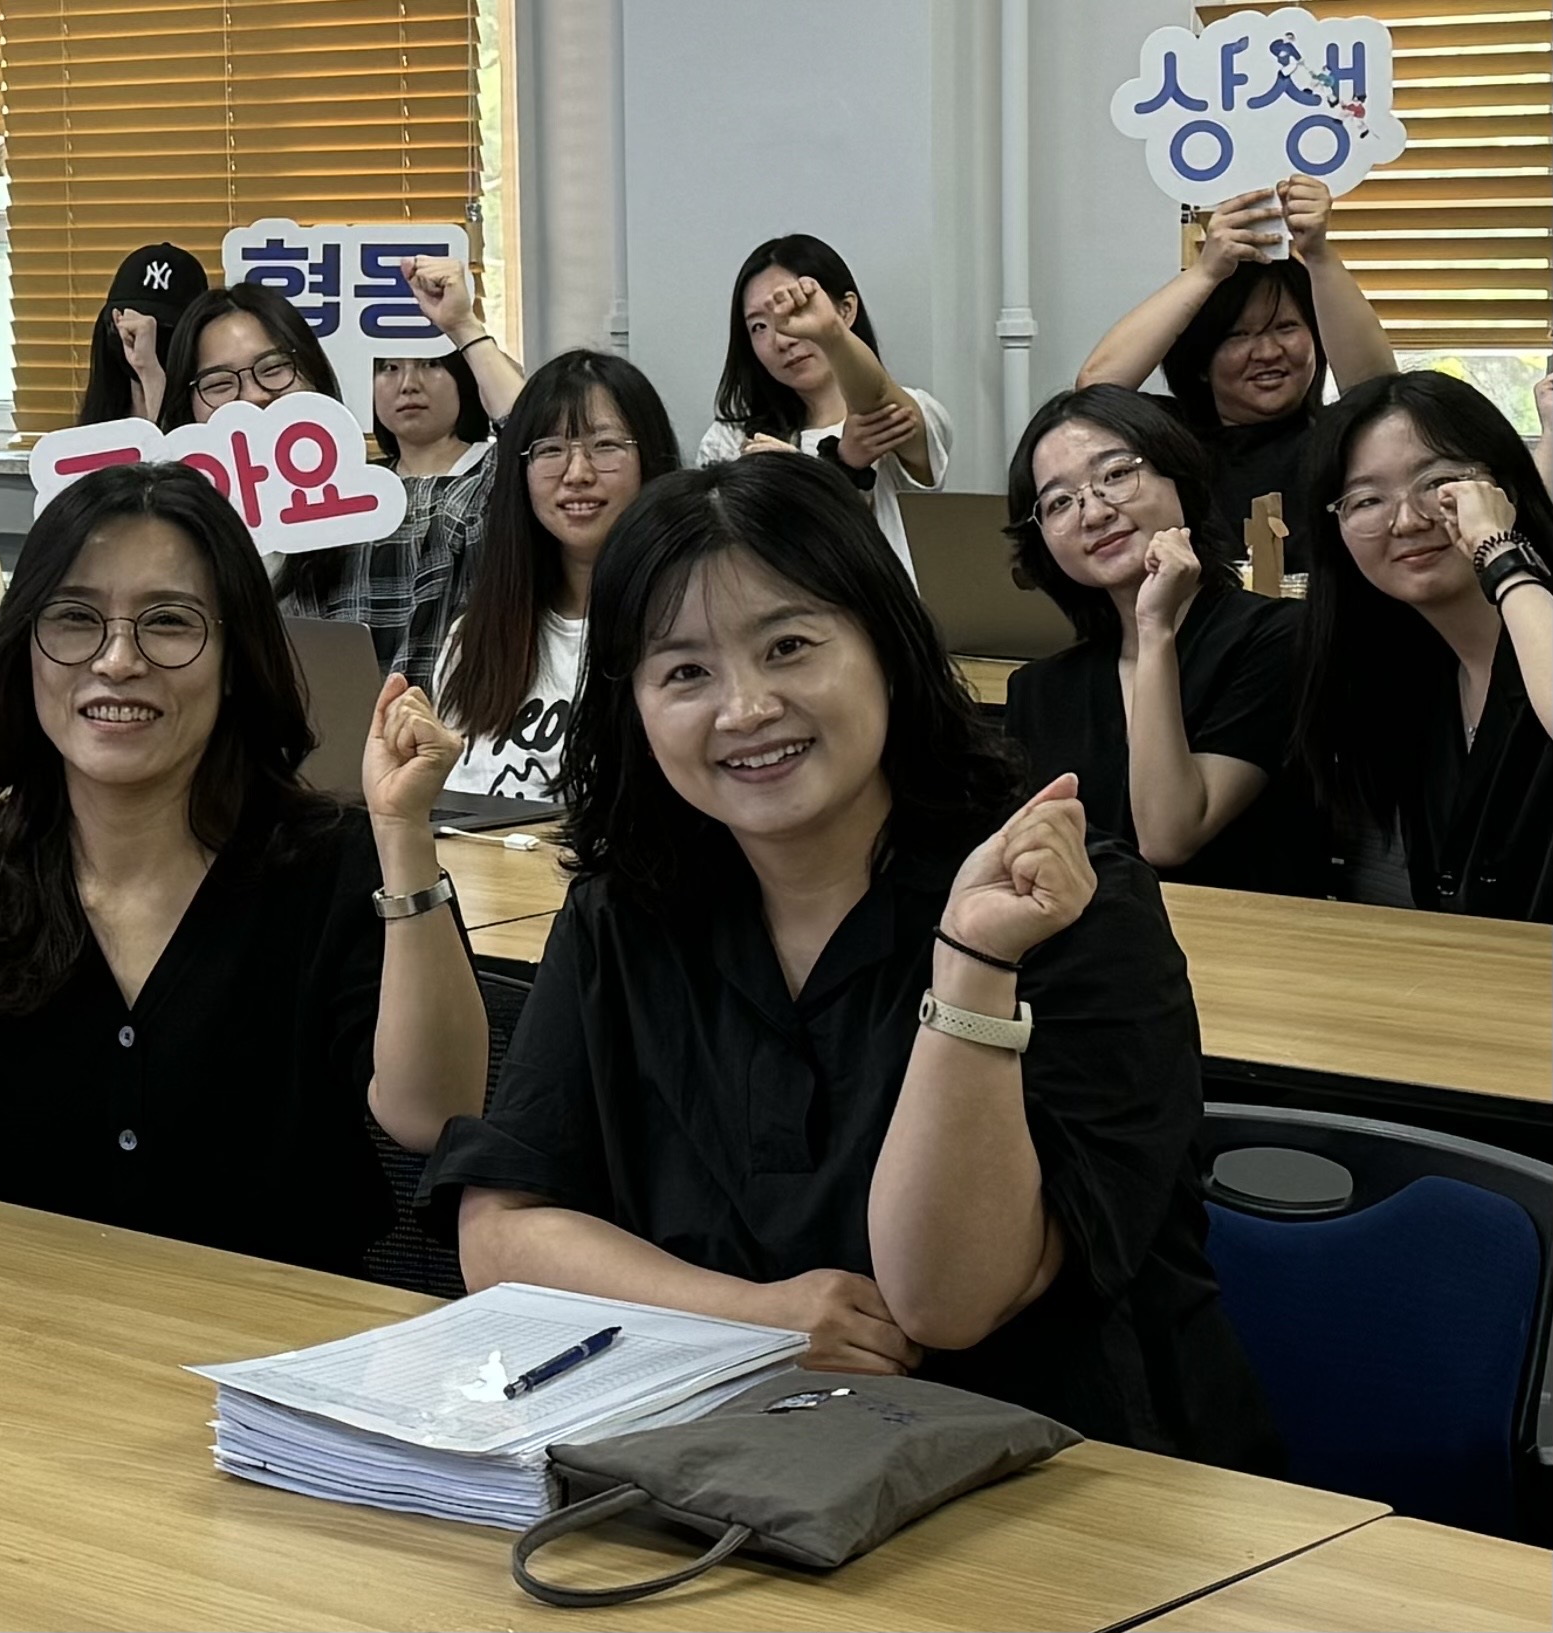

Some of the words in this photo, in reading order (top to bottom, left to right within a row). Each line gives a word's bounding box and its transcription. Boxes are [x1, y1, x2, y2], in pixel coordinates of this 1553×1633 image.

[1134, 36, 1367, 183] 상생
[143, 261, 173, 290] NY
[241, 238, 450, 339] 협동
[54, 421, 379, 529] 아요
